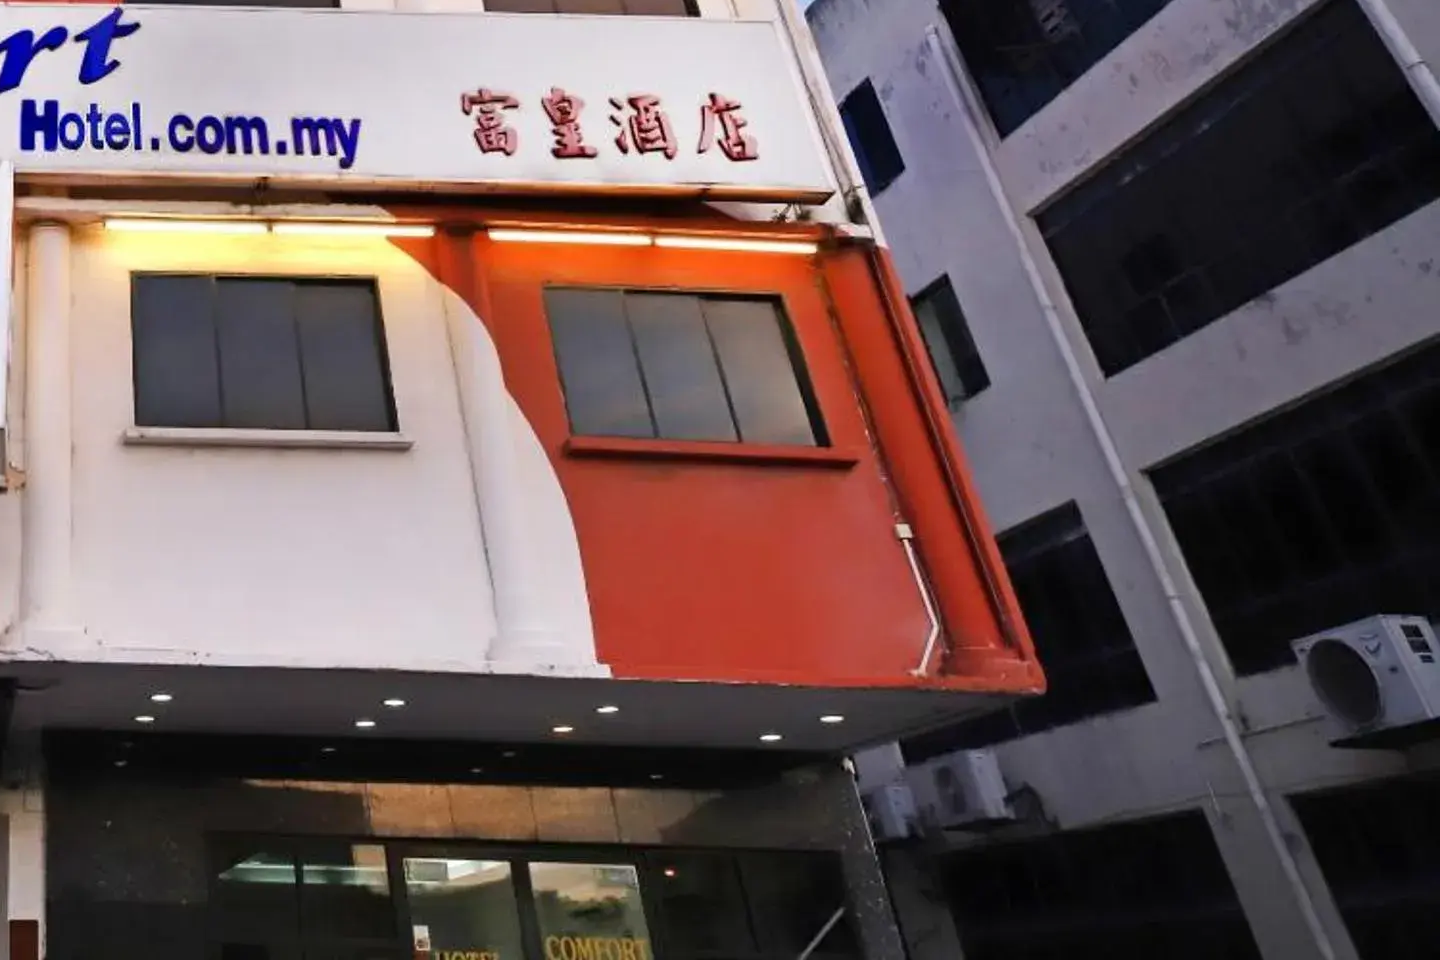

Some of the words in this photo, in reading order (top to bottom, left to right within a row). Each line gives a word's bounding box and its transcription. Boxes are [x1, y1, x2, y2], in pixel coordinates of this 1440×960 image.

[19, 99, 361, 169] Hotel.com.my
[460, 87, 759, 162] 富皇酒店
[544, 933, 650, 960] COMFORT
